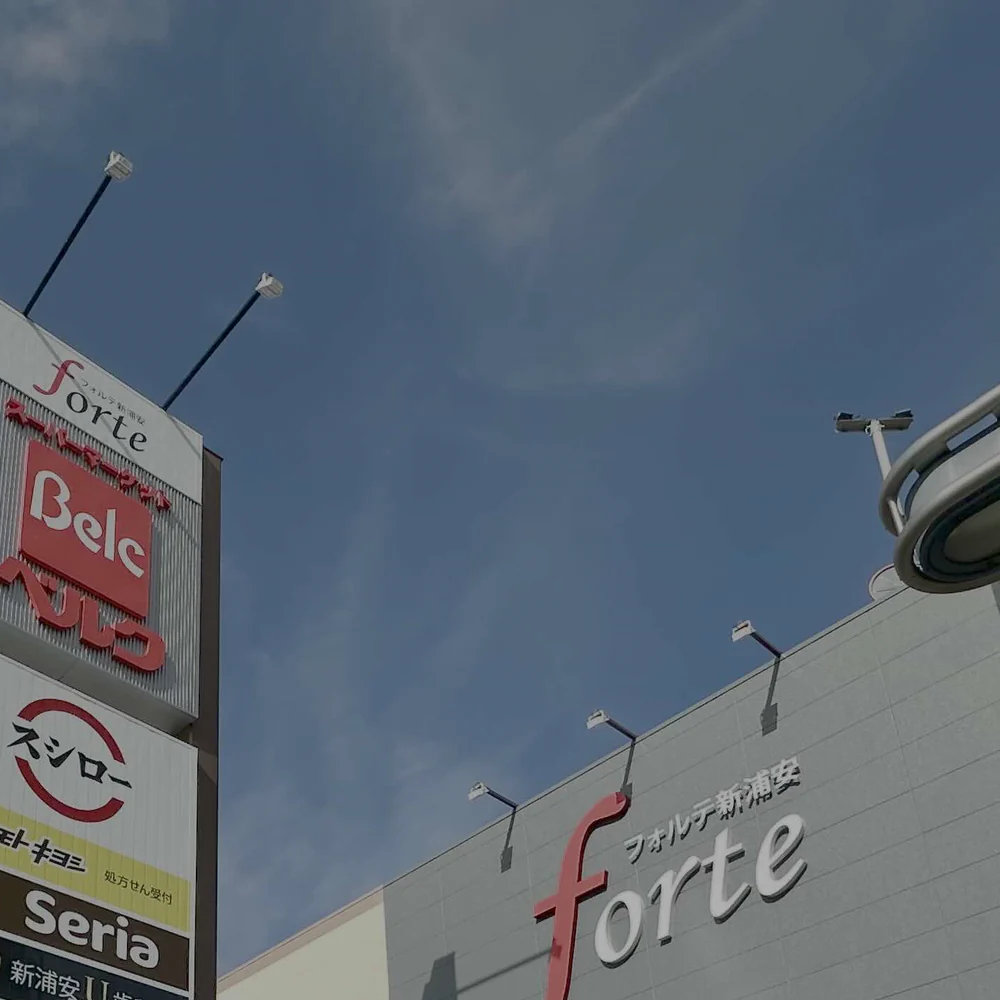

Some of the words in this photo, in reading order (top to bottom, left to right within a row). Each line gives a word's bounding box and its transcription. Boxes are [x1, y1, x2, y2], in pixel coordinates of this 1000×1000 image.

[33, 359, 148, 452] forte
[30, 470, 146, 578] Belc
[7, 721, 133, 790] スシロー
[623, 756, 801, 864] フォルテ新浦安
[24, 888, 160, 970] Seria
[104, 869, 173, 905] 処方せん受付
